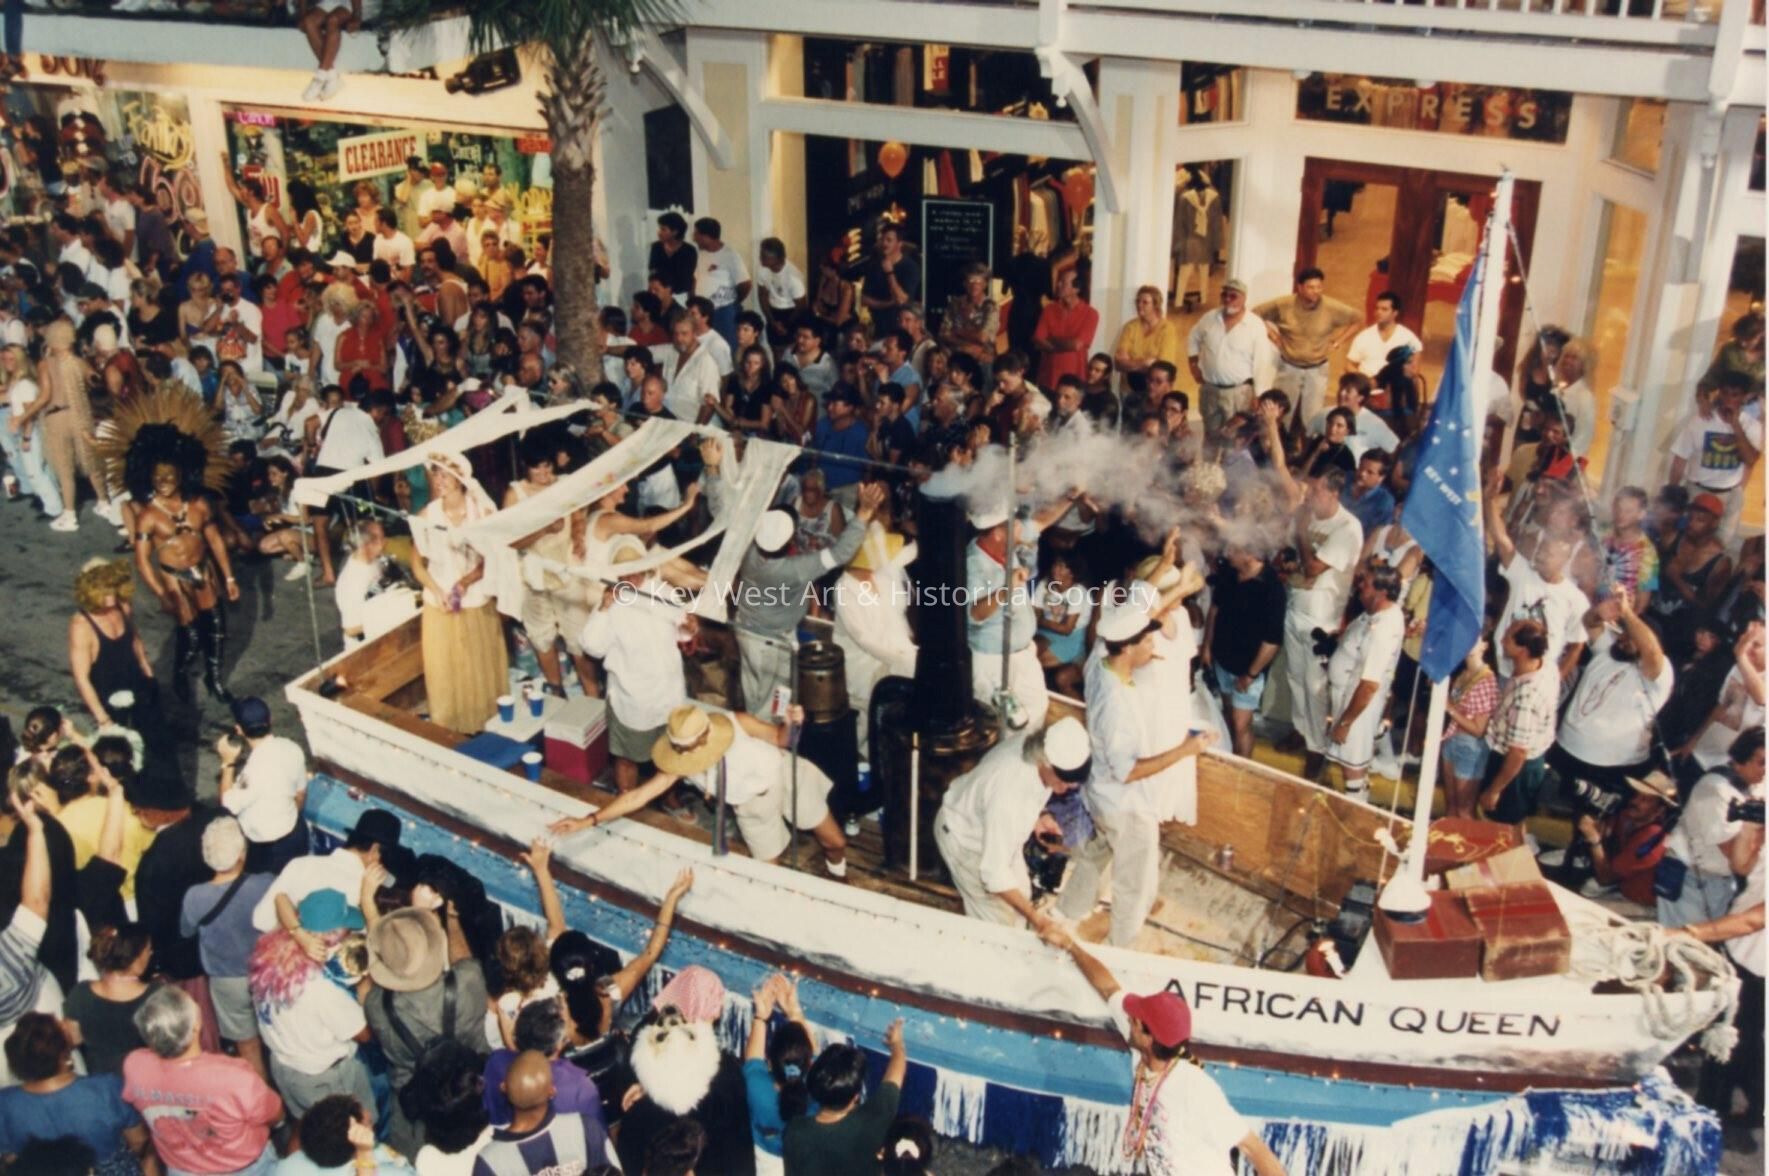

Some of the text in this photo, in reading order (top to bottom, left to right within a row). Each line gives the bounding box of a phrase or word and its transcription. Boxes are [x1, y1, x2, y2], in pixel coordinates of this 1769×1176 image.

[1326, 86, 1537, 129] EXPRESS
[345, 135, 416, 174] CLEARANCE
[1163, 978, 1561, 1037] AFRICAN QUEEN
